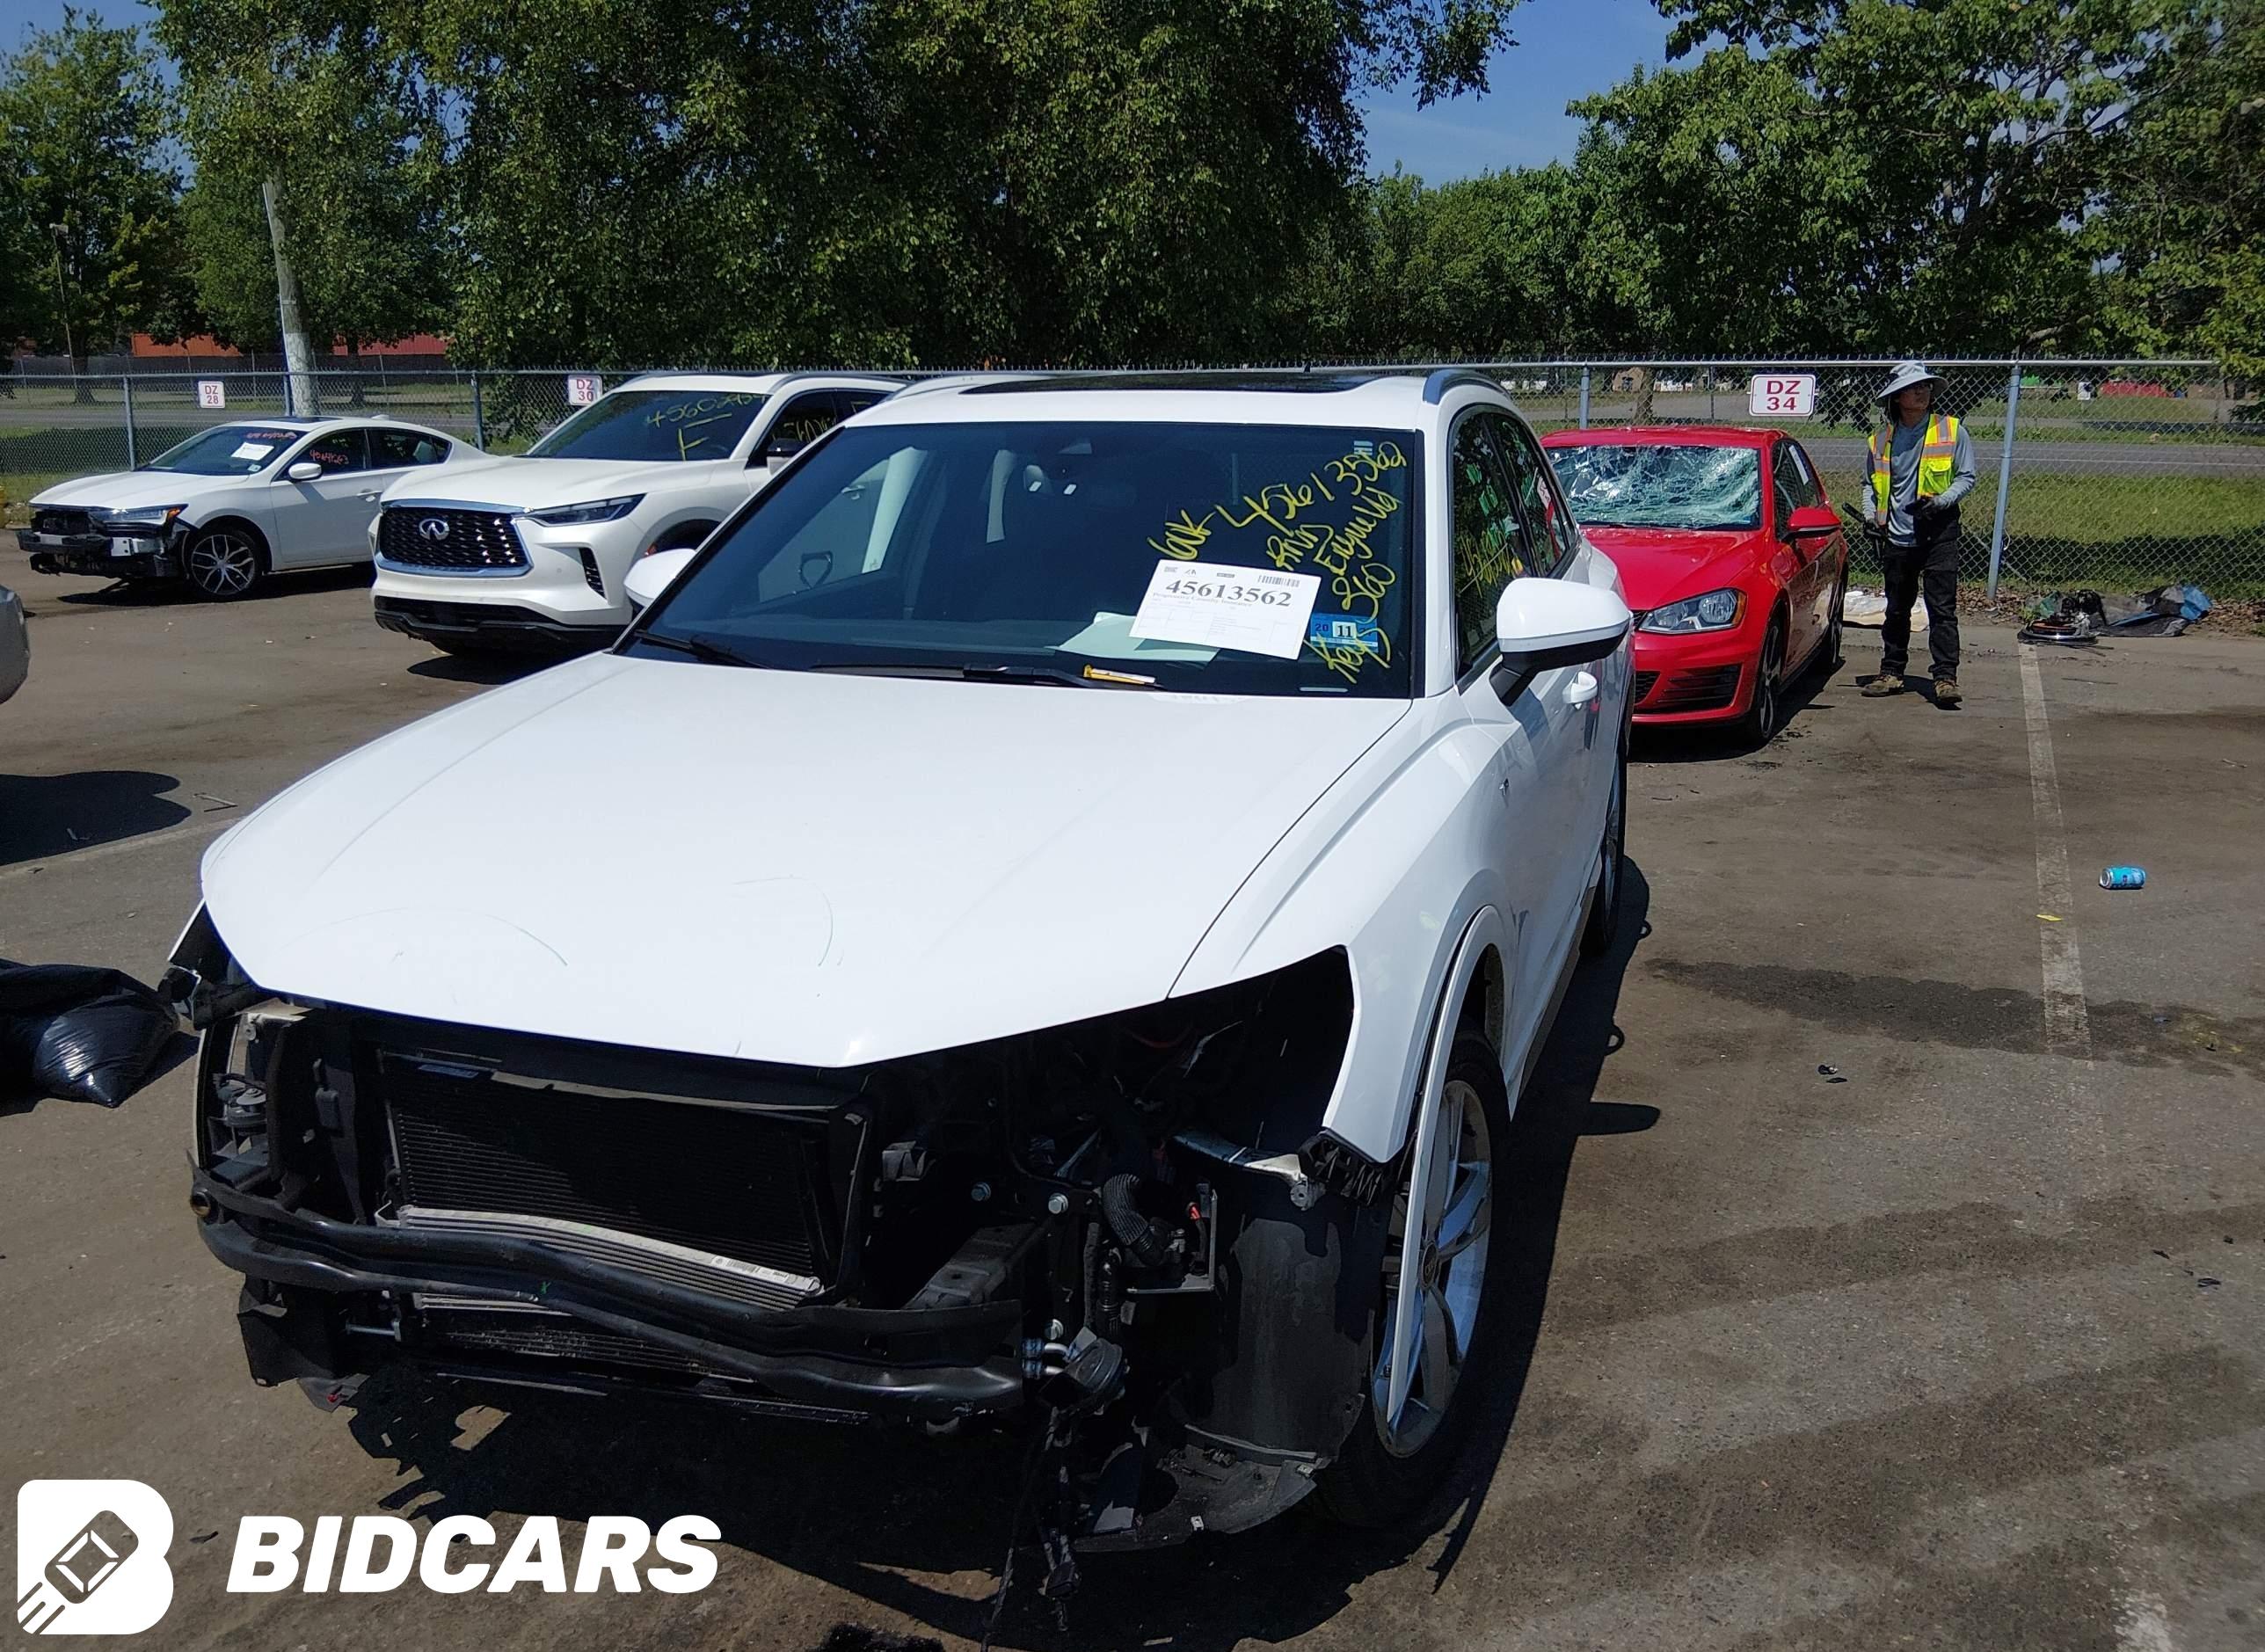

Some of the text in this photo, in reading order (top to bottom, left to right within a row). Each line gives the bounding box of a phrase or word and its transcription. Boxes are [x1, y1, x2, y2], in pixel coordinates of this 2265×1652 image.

[204, 385, 219, 395] DZ
[576, 379, 594, 390] DZ
[1766, 380, 1802, 395] DZ
[207, 395, 219, 404] 28
[578, 390, 594, 402] 30
[1766, 397, 1797, 411] 34
[1165, 579, 1293, 608] 45613562
[1336, 624, 1353, 638] 11
